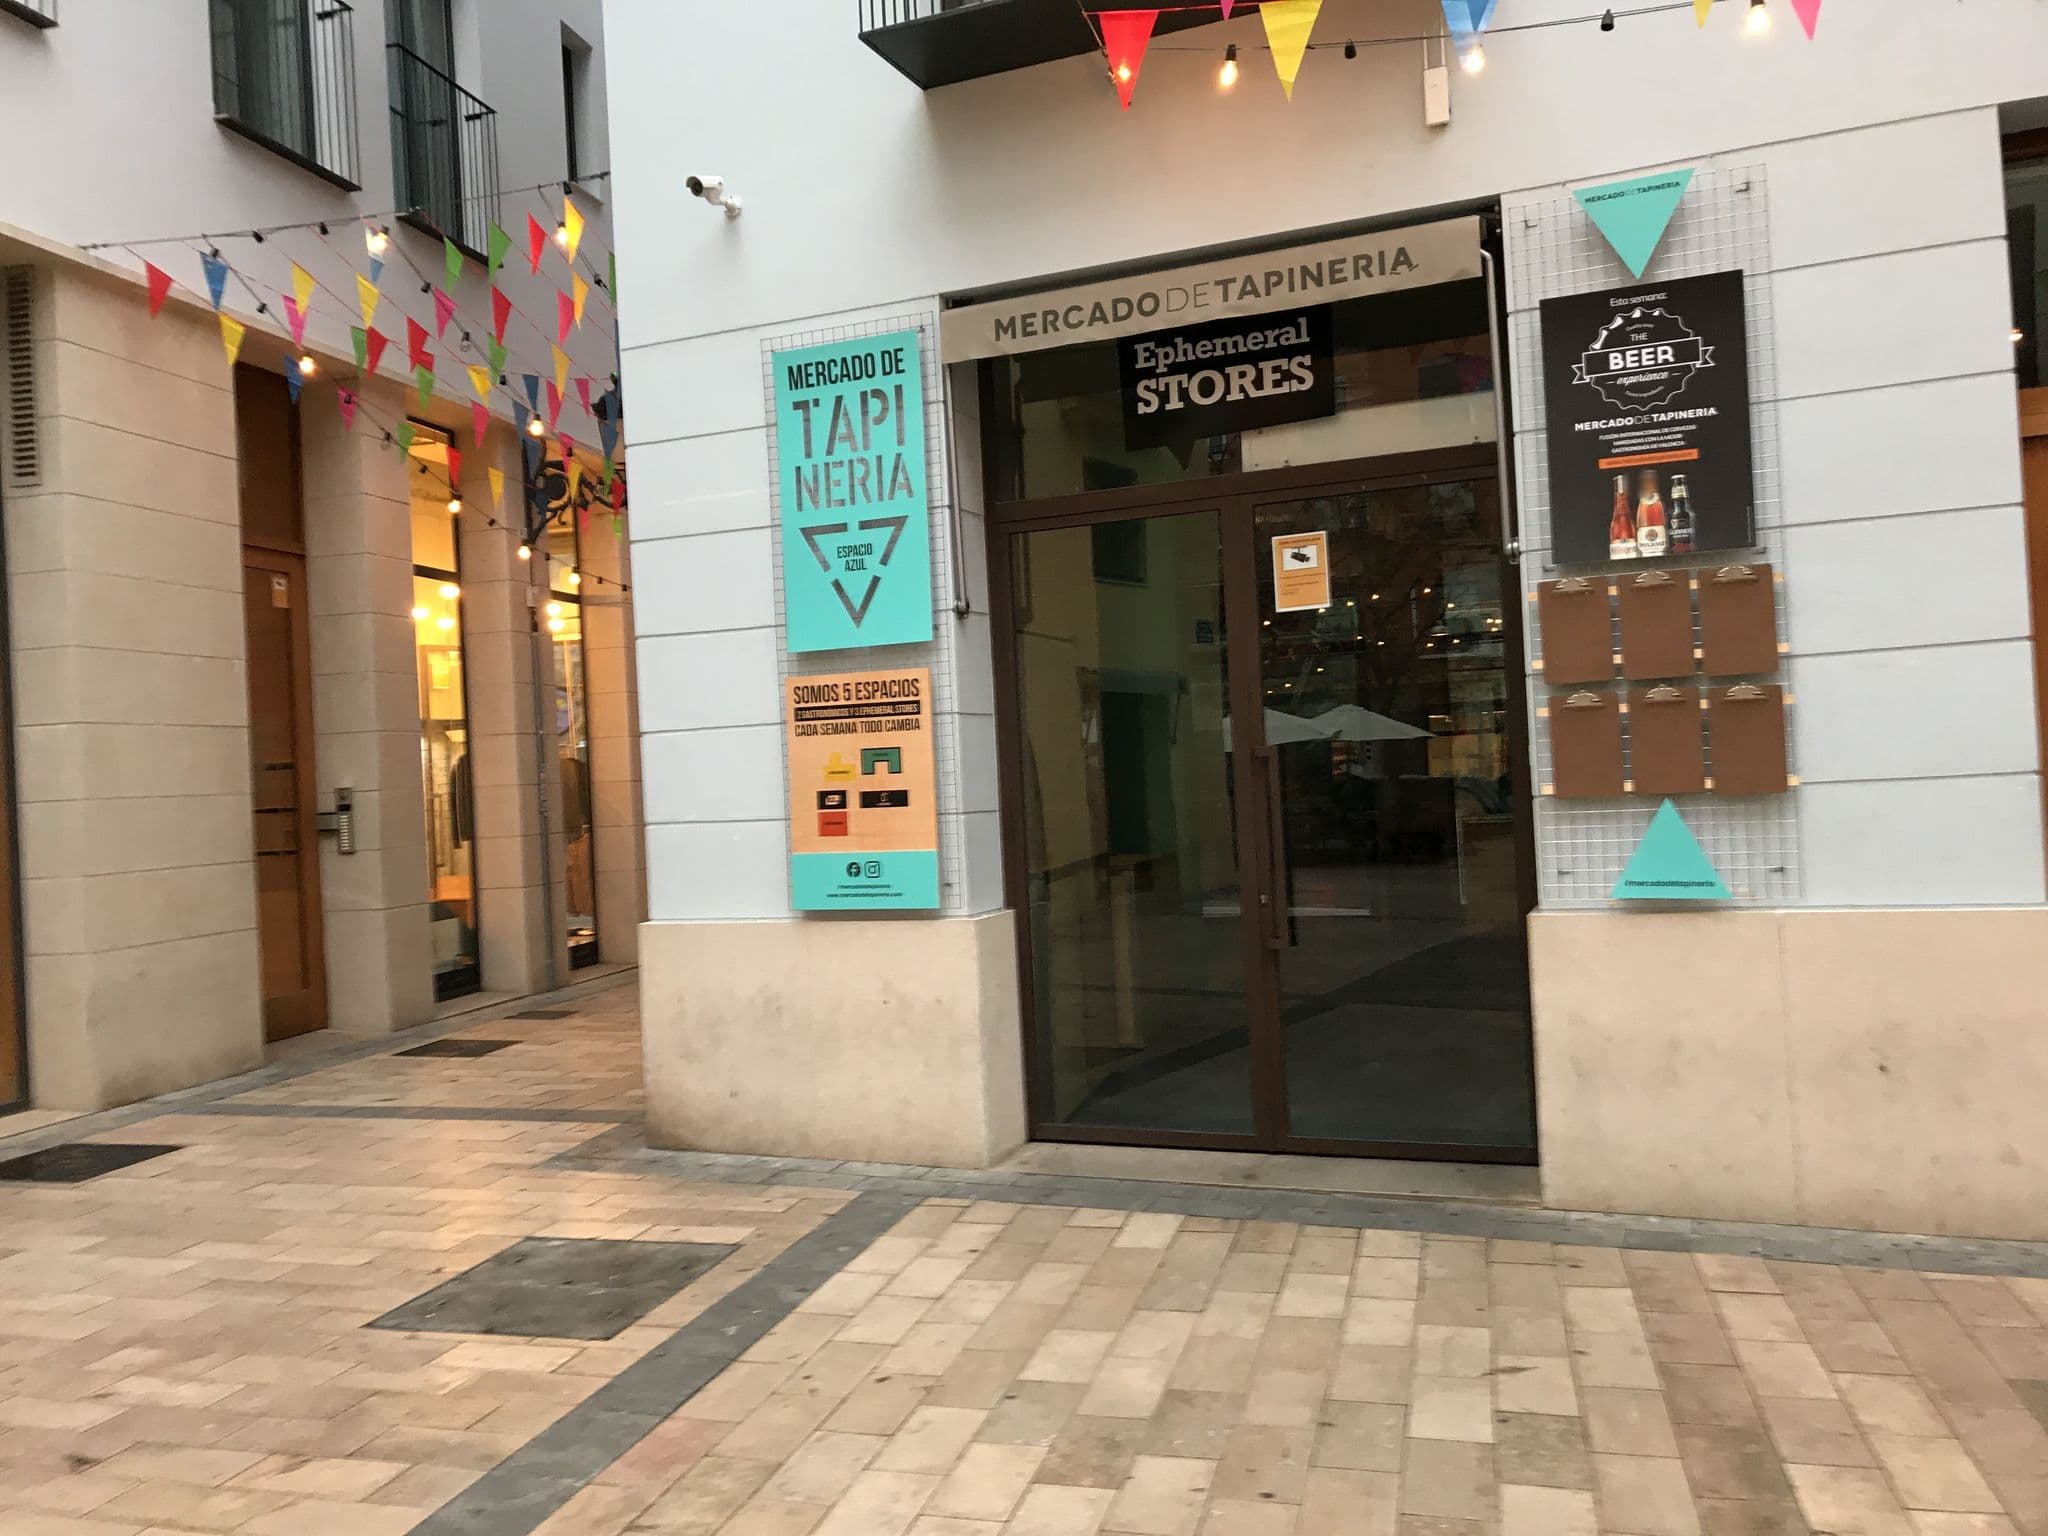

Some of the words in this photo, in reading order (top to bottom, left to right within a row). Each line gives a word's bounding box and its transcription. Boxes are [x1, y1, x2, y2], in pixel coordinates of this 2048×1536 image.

[1609, 297, 1629, 307] Esta
[1134, 317, 1311, 374] Ephemeral
[1629, 332, 1649, 342] THE
[787, 352, 876, 390] MERCADO
[881, 347, 905, 376] DE
[1608, 345, 1674, 370] BEER
[1136, 354, 1314, 416] STORES
[1616, 371, 1669, 386] experience
[792, 384, 905, 459] TAPI
[795, 452, 914, 513] NERIA
[837, 543, 873, 559] ESPACIO
[844, 557, 867, 573] AZUL
[793, 684, 839, 705] SOMOS
[843, 682, 851, 702] 5
[855, 678, 920, 701] ESPACIOS
[895, 703, 918, 714] STORES
[794, 723, 818, 737] CADA
[820, 721, 857, 735] SEMANA
[860, 720, 882, 733] TODO
[885, 718, 920, 731] CAMBIA
